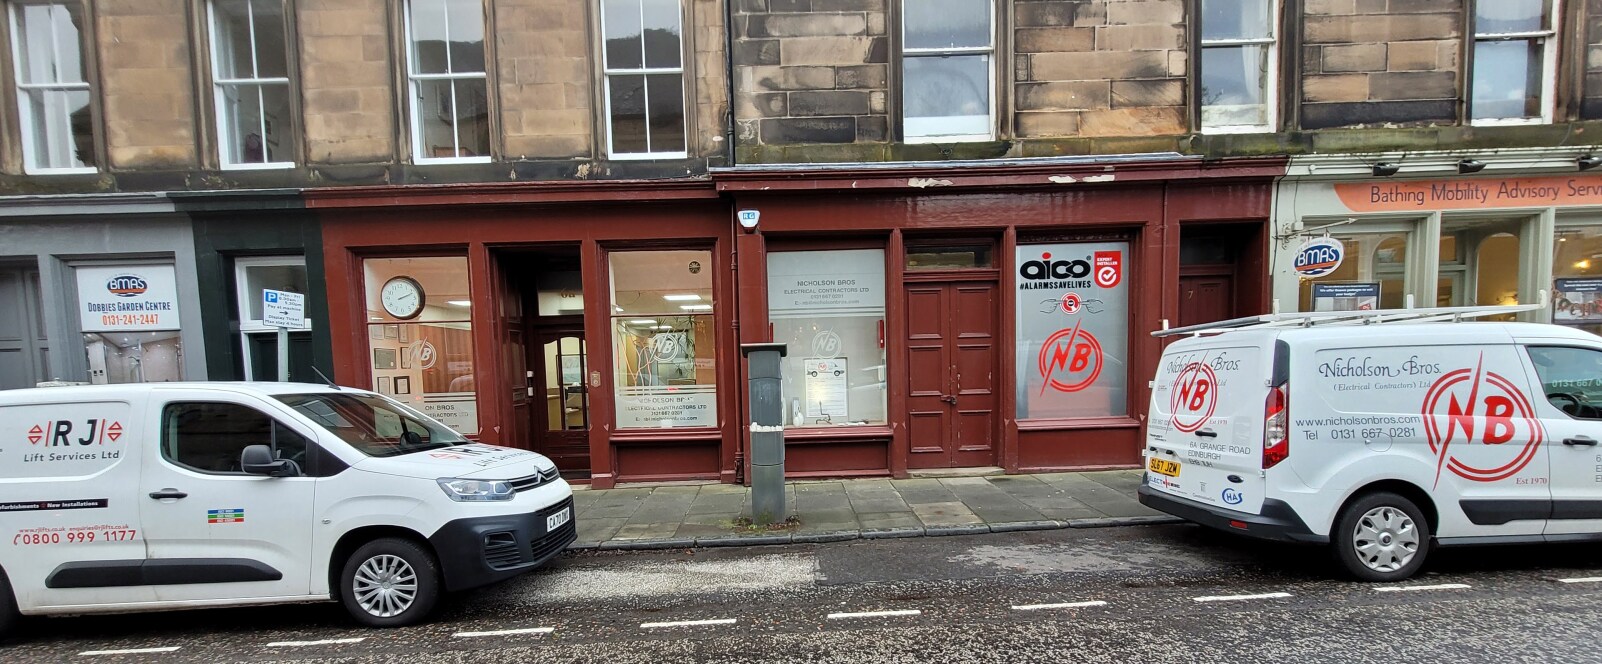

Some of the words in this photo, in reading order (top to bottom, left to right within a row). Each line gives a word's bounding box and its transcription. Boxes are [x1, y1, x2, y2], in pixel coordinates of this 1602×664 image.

[1370, 185, 1425, 206] Bathing
[1431, 182, 1489, 204] Mobility
[1497, 180, 1560, 201] Advisory
[1297, 247, 1337, 266] BMAS
[1019, 252, 1091, 280] aico
[110, 278, 146, 290] BMAS
[1019, 280, 1092, 290] #ALARMSSAVELIVES
[269, 292, 276, 303] P
[88, 302, 116, 313] DOBBIES
[118, 301, 144, 312] GARDEN
[145, 300, 172, 311] CENTRE
[102, 313, 159, 326] 0131-241-2447
[1210, 351, 1241, 371] Bros.
[1318, 356, 1401, 378] Nicholson
[1401, 355, 1442, 376] Bros.
[1333, 382, 1370, 391] (Electrical
[1374, 381, 1417, 390] Contractors)
[1419, 381, 1431, 389] Ltd
[1551, 380, 1573, 388] 0131
[1576, 379, 1593, 387] 667
[1295, 416, 1421, 427] www.nicholsonbros.com
[1303, 430, 1319, 441] Tel
[1331, 428, 1356, 440] 0131
[1361, 428, 1382, 439] 667
[1389, 427, 1416, 438] 0281
[1189, 441, 1198, 449] 6A
[1199, 442, 1226, 453] GRANGE
[1228, 445, 1251, 455] ROAD
[24, 453, 44, 463] Lift
[48, 452, 97, 462] Services
[101, 450, 120, 460] Ltd
[1187, 449, 1221, 461] EDINBURGH
[1516, 477, 1529, 485] Est
[1531, 477, 1548, 485] 1970
[23, 533, 60, 545] 0800
[67, 531, 95, 543] 999
[103, 529, 137, 541] 1177
